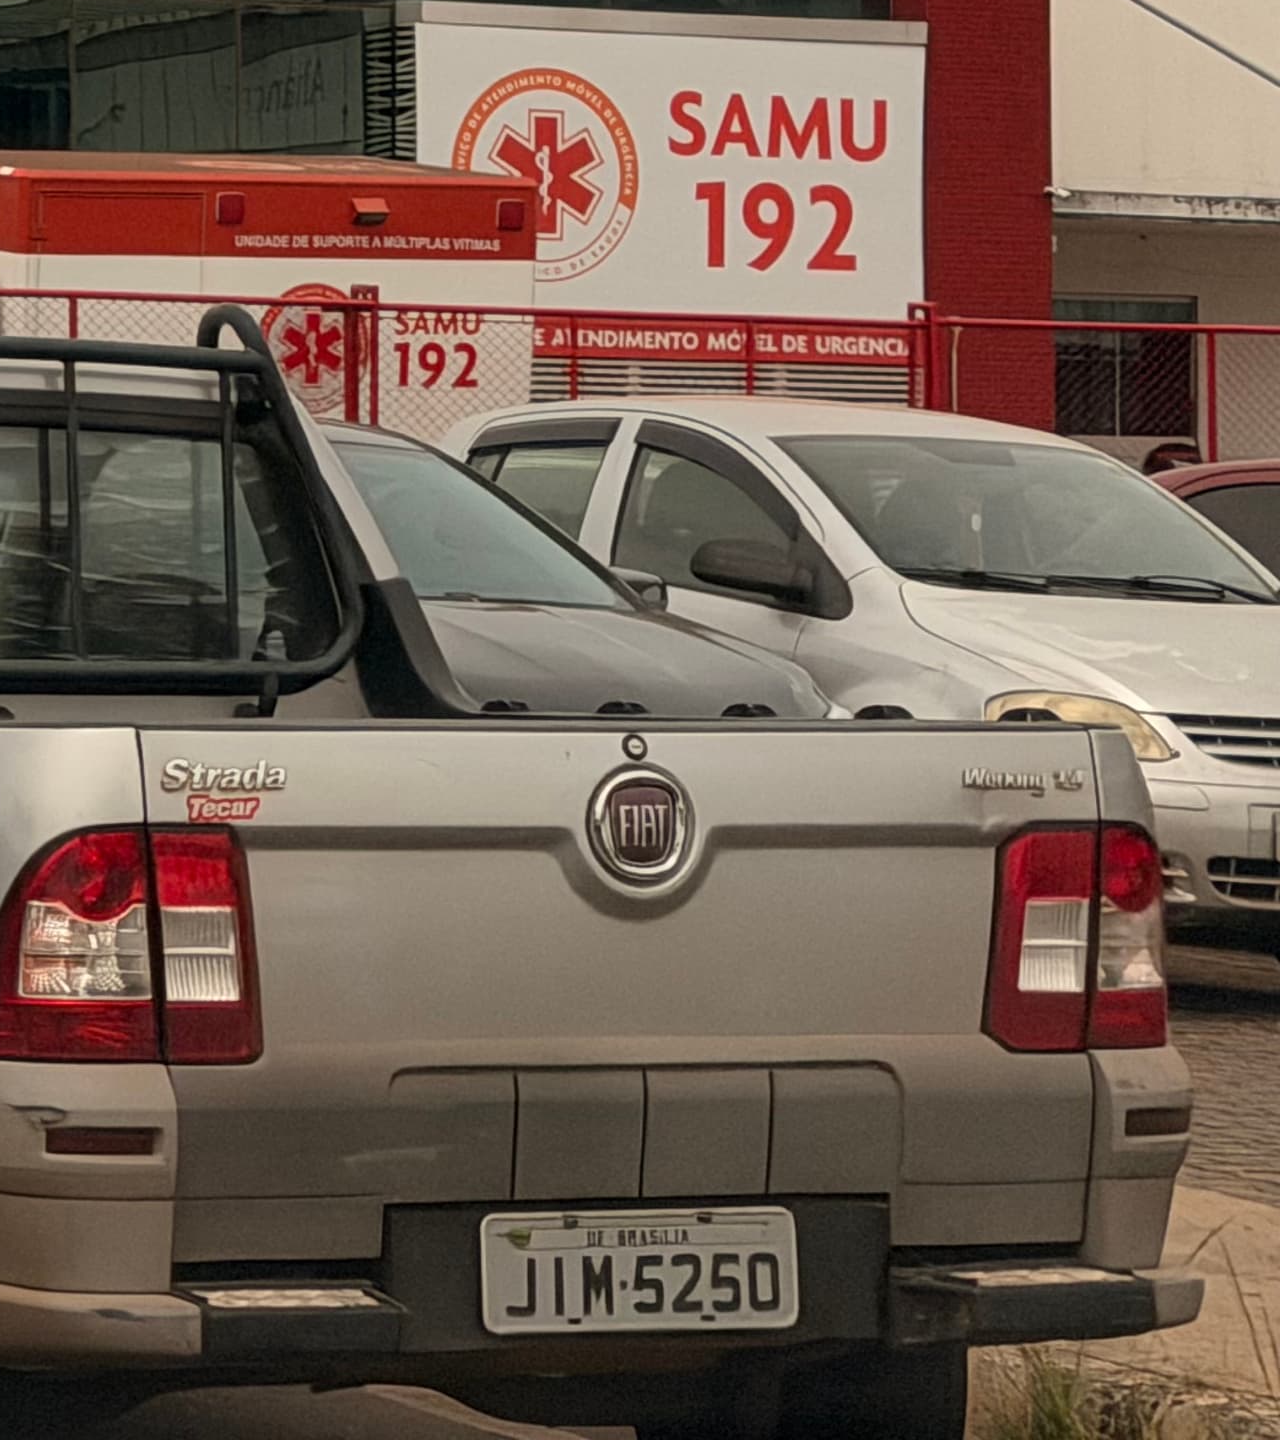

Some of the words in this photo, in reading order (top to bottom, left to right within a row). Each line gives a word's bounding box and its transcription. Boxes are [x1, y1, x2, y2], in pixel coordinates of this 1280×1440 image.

[668, 90, 888, 162] SAMU
[235, 235, 290, 248] UNIDADE
[292, 235, 309, 248] DE
[312, 235, 370, 249] SUPORTE
[372, 236, 382, 248] A
[695, 181, 857, 271] 192
[394, 312, 485, 335] SAMU
[782, 335, 808, 353] DE
[393, 342, 478, 389] 192
[161, 758, 286, 792] Strada
[189, 797, 258, 820] Tecar
[619, 804, 668, 851] FIAT
